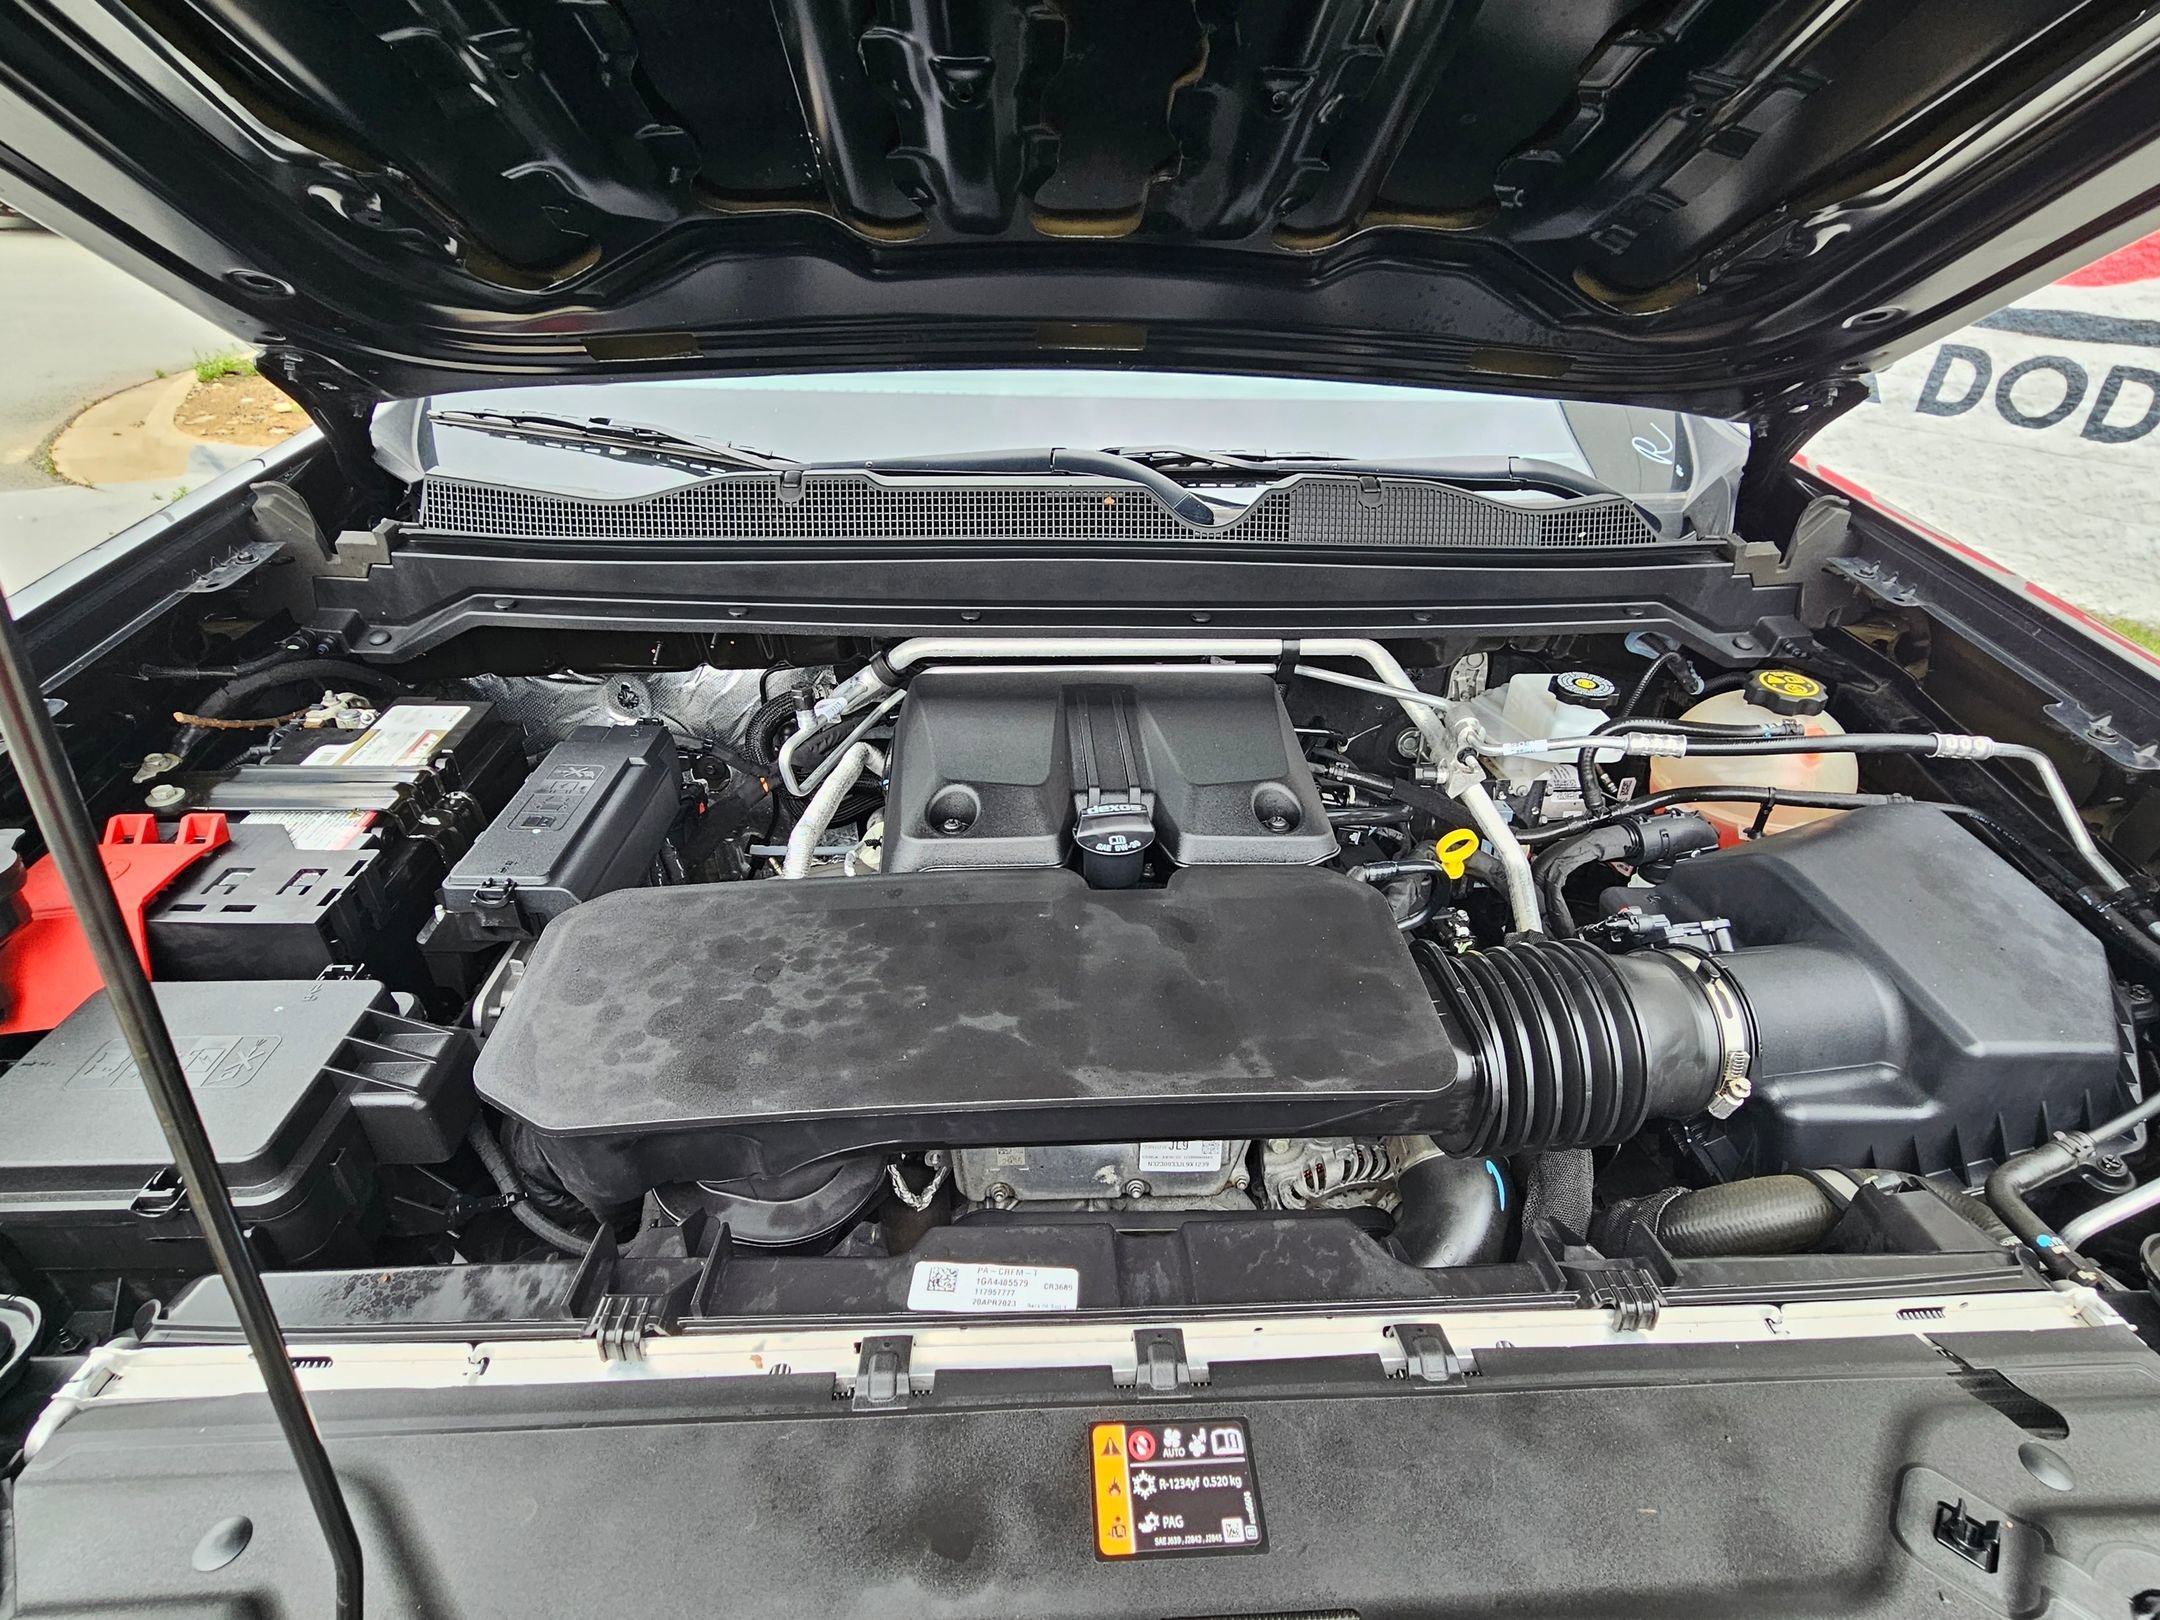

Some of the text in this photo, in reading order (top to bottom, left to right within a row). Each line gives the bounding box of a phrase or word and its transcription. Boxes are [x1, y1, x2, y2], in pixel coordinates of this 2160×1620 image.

[1086, 804, 1142, 815] dexos
[1162, 1447, 1186, 1458] AUTO
[1159, 1473, 1243, 1491] R-1234yf 0.520 kg
[1162, 1515, 1184, 1529] PAG
